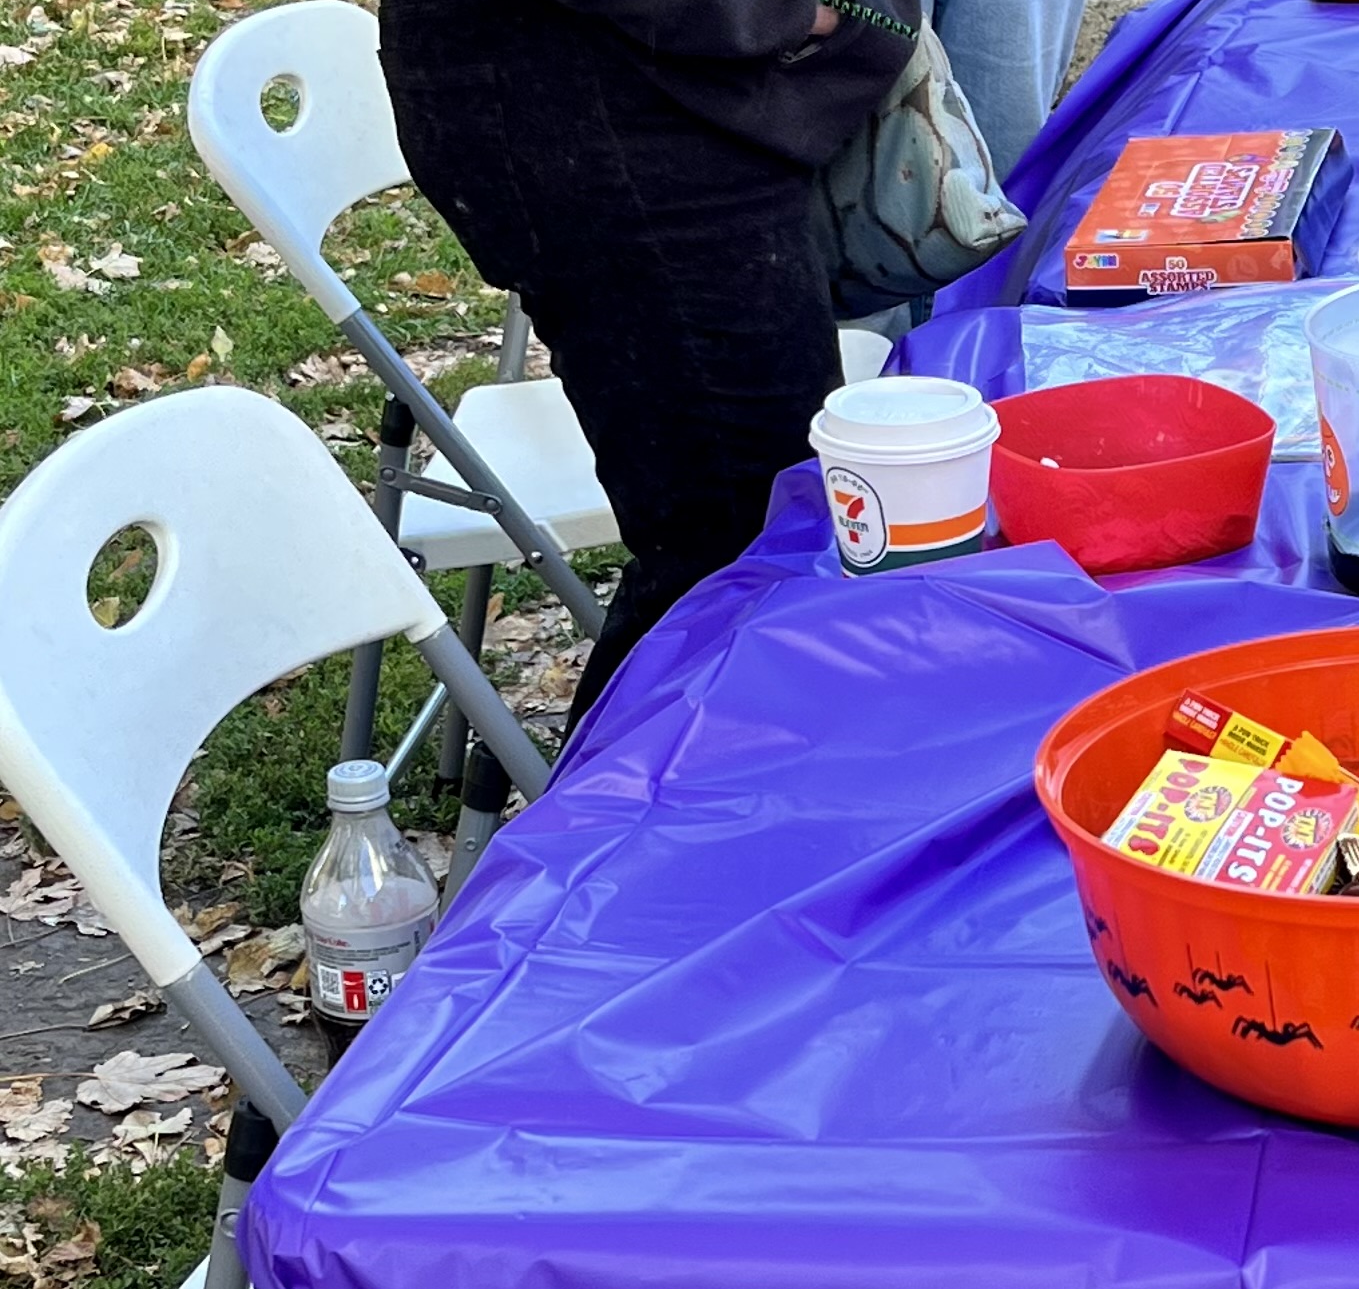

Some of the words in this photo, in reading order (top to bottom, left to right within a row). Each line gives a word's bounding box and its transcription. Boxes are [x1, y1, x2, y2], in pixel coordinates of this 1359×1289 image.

[1168, 259, 1184, 270] 50
[1141, 271, 1214, 283] ASSORTED
[1149, 282, 1208, 293] STAMPS
[1128, 758, 1209, 856] POP-ITS
[1228, 776, 1304, 884] POP-ITS
